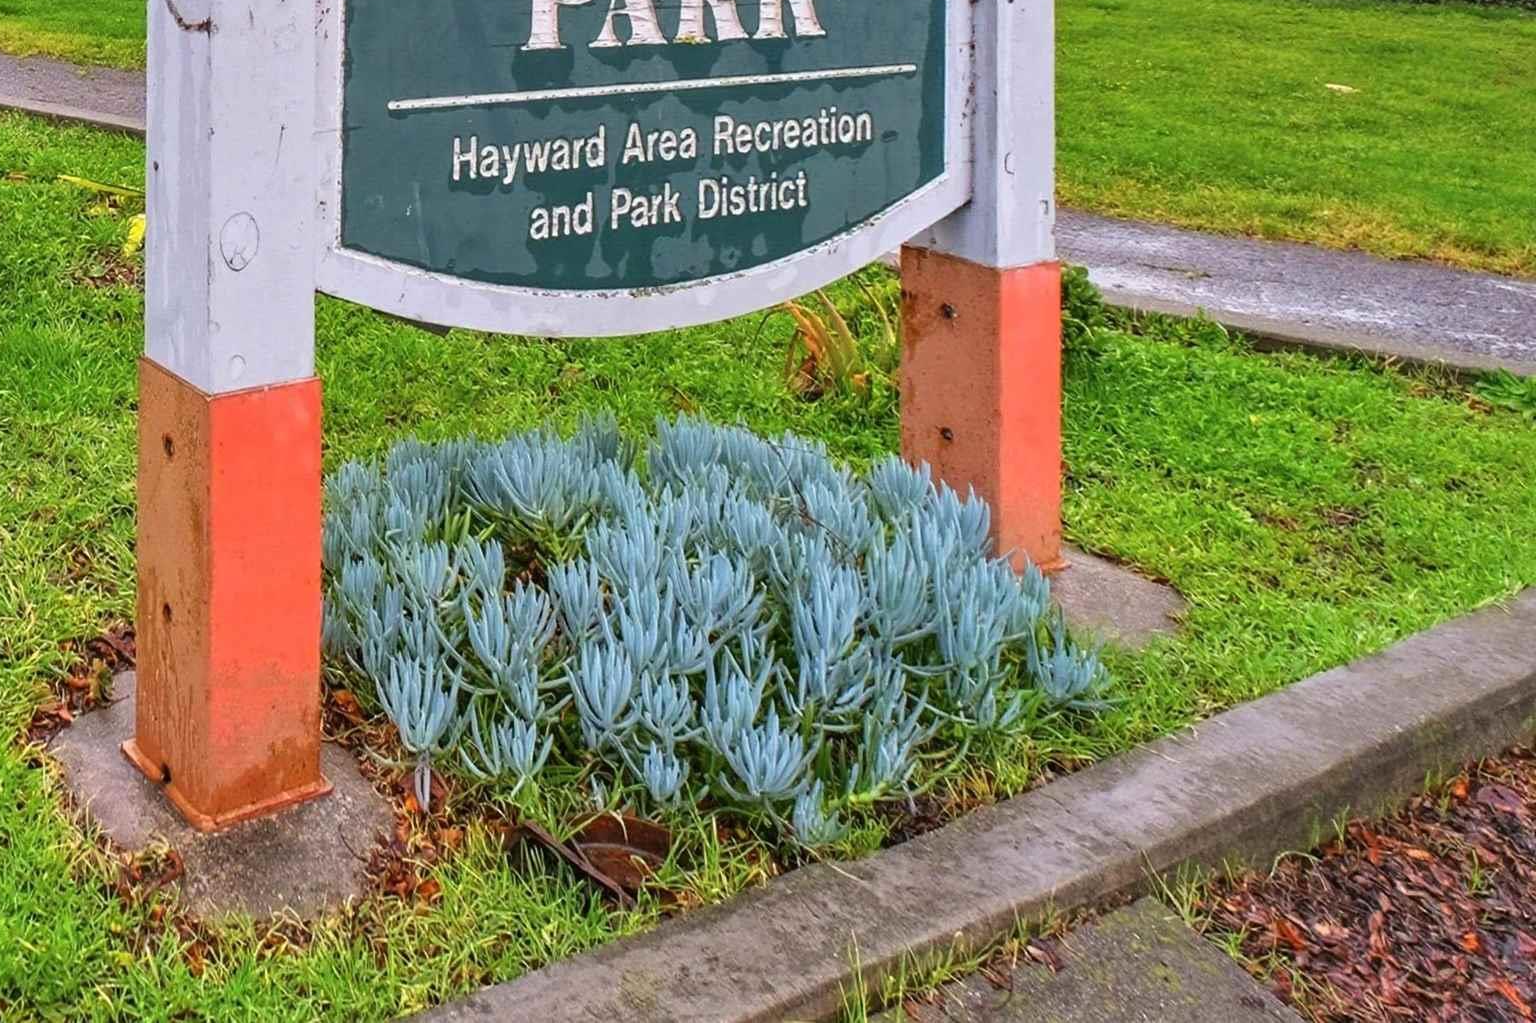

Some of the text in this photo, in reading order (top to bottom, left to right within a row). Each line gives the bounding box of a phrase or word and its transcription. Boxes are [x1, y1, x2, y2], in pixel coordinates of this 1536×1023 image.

[452, 108, 872, 184] Hayward Area Recreation
[529, 171, 808, 240] and Park District
